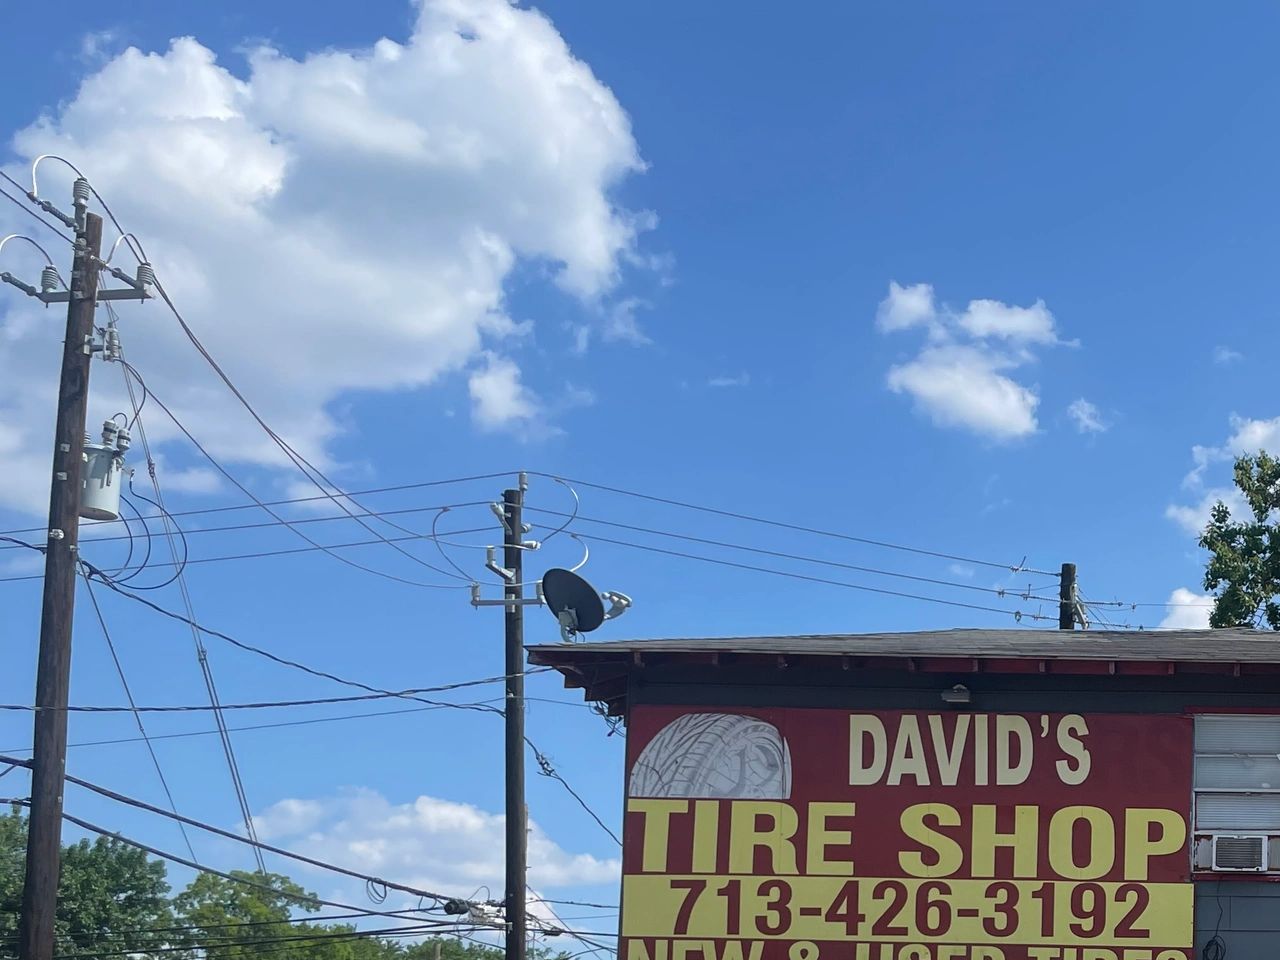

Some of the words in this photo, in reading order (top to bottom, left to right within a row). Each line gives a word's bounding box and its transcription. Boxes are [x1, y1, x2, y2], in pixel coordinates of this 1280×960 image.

[848, 714, 1091, 786] DAVID'S
[627, 800, 856, 876] TIRE
[898, 803, 1187, 881] SHOP
[669, 879, 1151, 939] 713-426-3192
